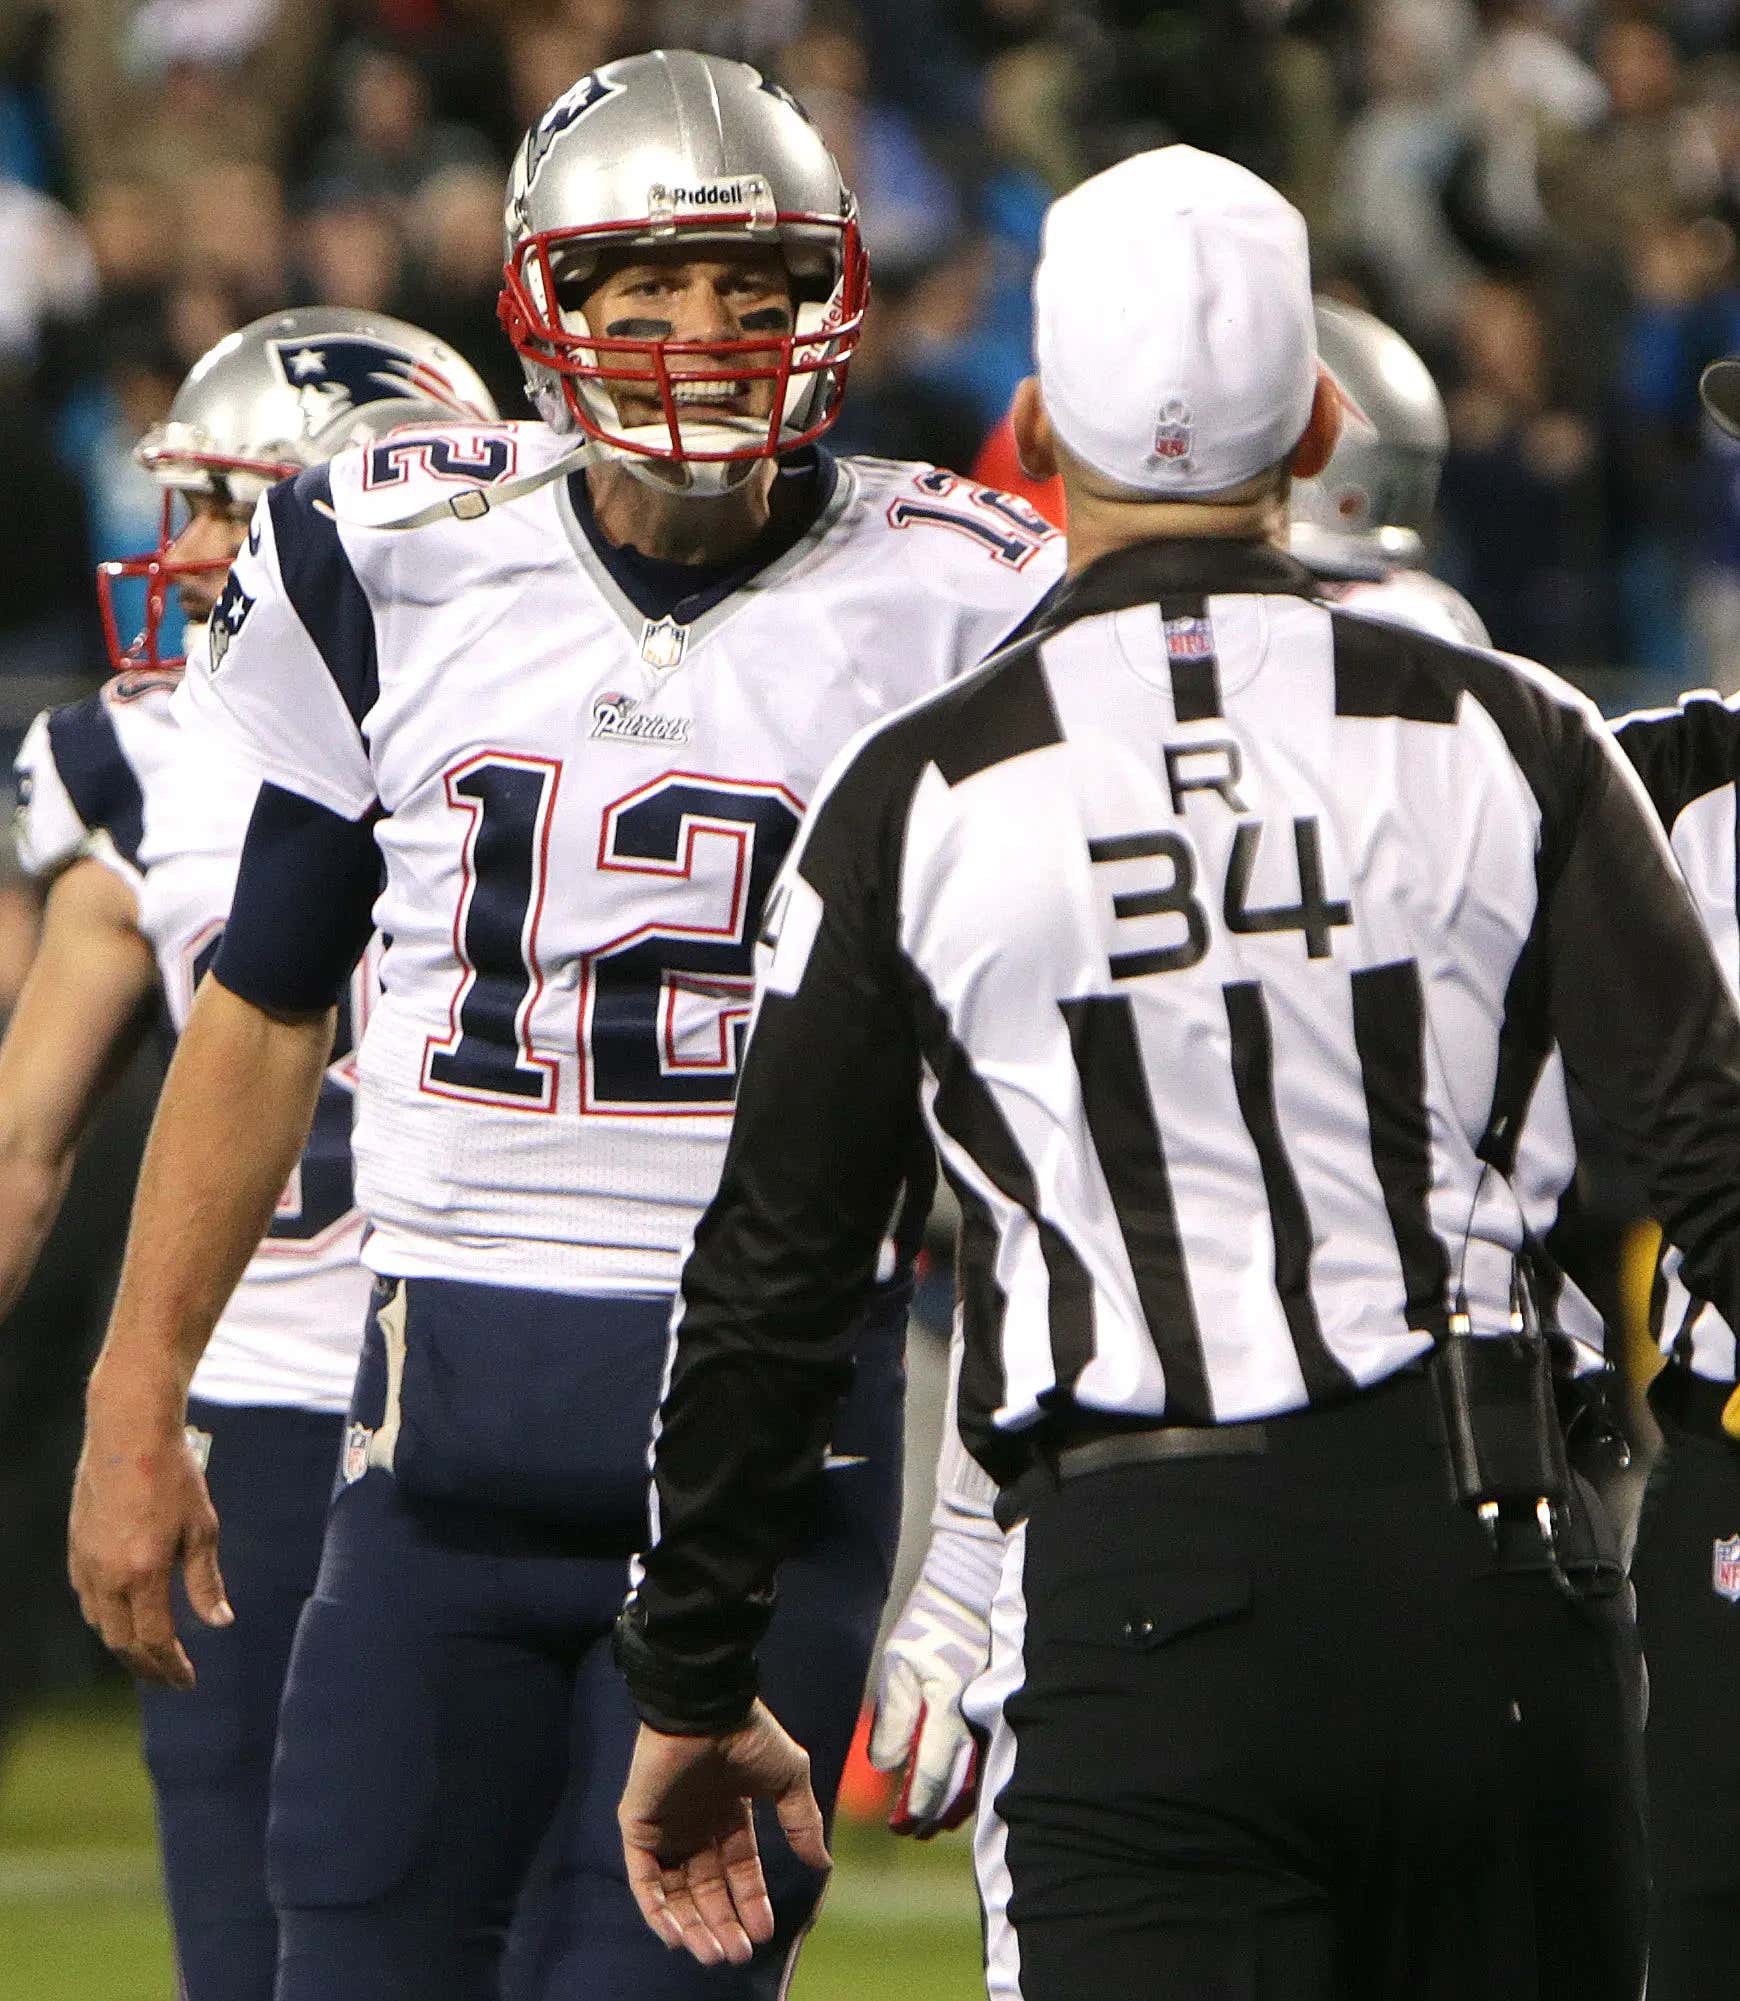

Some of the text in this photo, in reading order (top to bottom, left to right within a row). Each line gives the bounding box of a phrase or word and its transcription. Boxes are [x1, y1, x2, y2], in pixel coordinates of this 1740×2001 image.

[674, 181, 742, 204] Riddell
[590, 706, 690, 746] Patriots
[1164, 738, 1251, 816] R
[420, 750, 806, 1116] 12
[1088, 815, 1354, 981] 34
